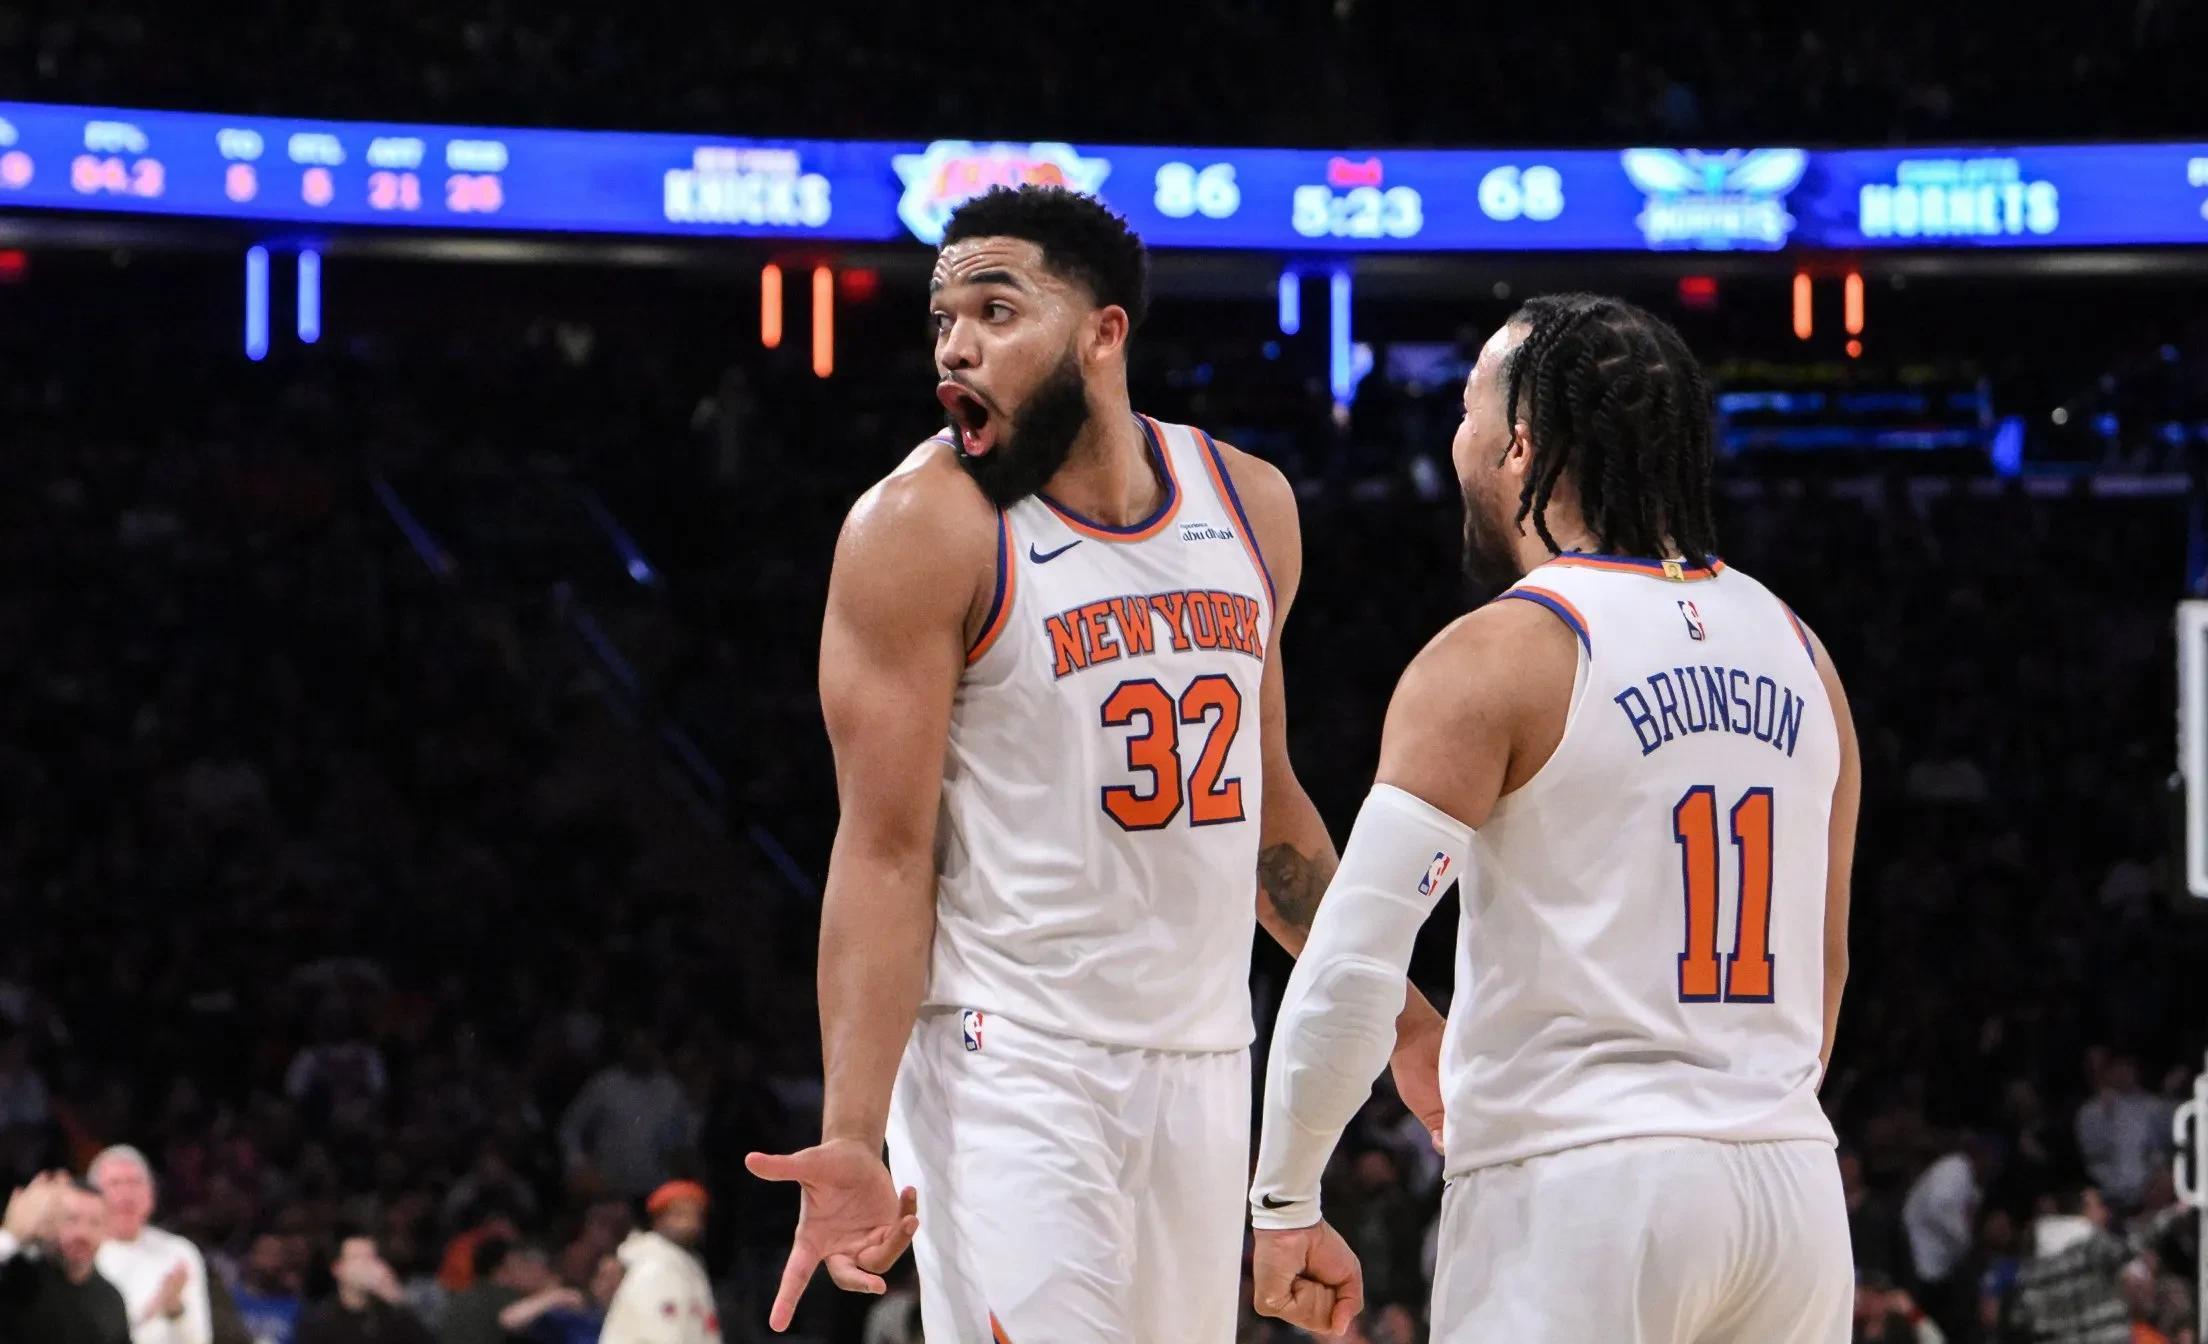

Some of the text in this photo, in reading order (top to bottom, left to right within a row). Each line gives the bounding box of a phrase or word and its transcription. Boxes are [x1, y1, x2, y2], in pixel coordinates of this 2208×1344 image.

[1154, 162, 1241, 219] 86
[1292, 184, 1424, 239] 5:23
[1478, 164, 1565, 222] 68
[1860, 181, 2060, 237] HORNETS
[1183, 530, 1205, 541] abu
[1044, 590, 1263, 681] NEW YORK
[1613, 665, 1805, 758] BRUNSON
[1100, 673, 1246, 832] 32
[1672, 784, 1775, 1003] 11
